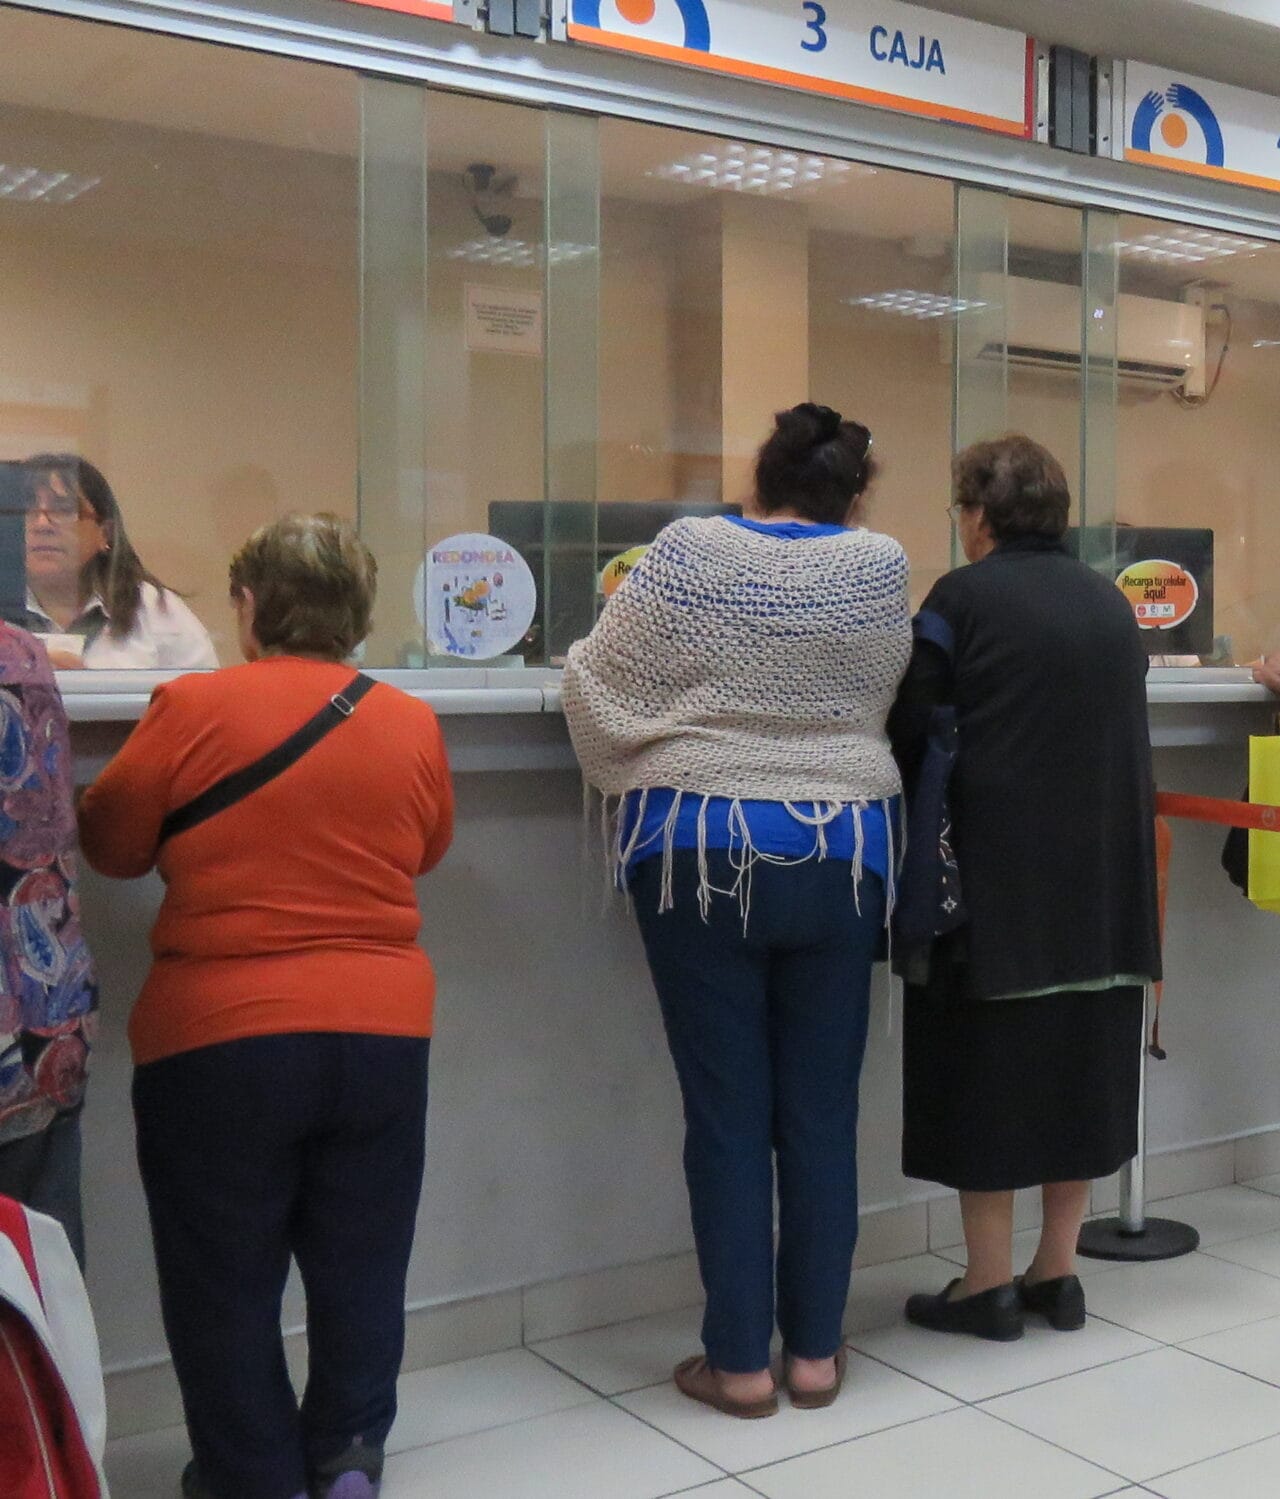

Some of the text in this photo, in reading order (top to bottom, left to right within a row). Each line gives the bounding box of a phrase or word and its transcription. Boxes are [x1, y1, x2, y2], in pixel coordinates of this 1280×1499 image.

[801, 1, 946, 75] 3 CAJA
[432, 549, 515, 565] REDONDEA
[1122, 574, 1187, 590] ¡Recarga tu celular
[1143, 586, 1166, 602] aquí!
